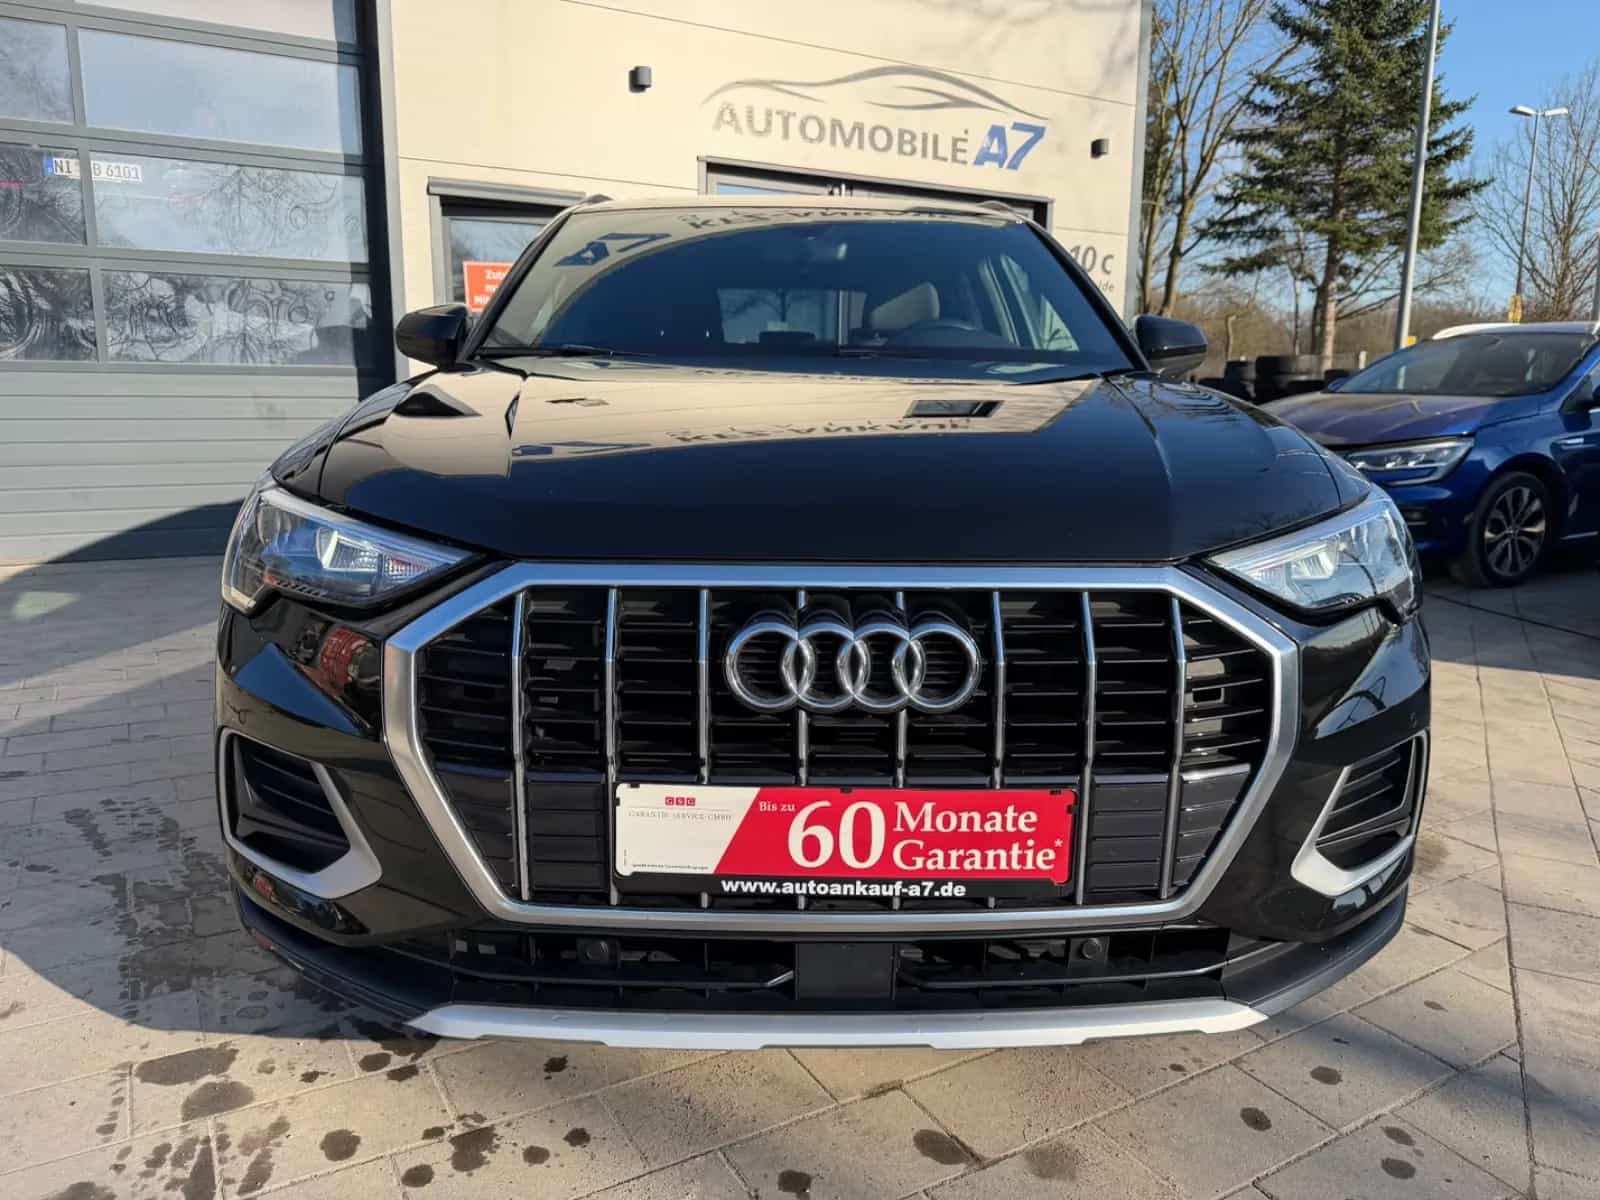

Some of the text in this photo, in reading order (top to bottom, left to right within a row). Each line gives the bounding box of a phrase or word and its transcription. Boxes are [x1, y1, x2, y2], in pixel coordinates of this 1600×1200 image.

[712, 101, 1046, 171] AUTOMOBILE A7
[759, 801, 796, 814] Bis zu
[893, 802, 1038, 832] Monate
[787, 800, 887, 869] 60
[721, 878, 967, 898] www.autoankauf-a7.de
